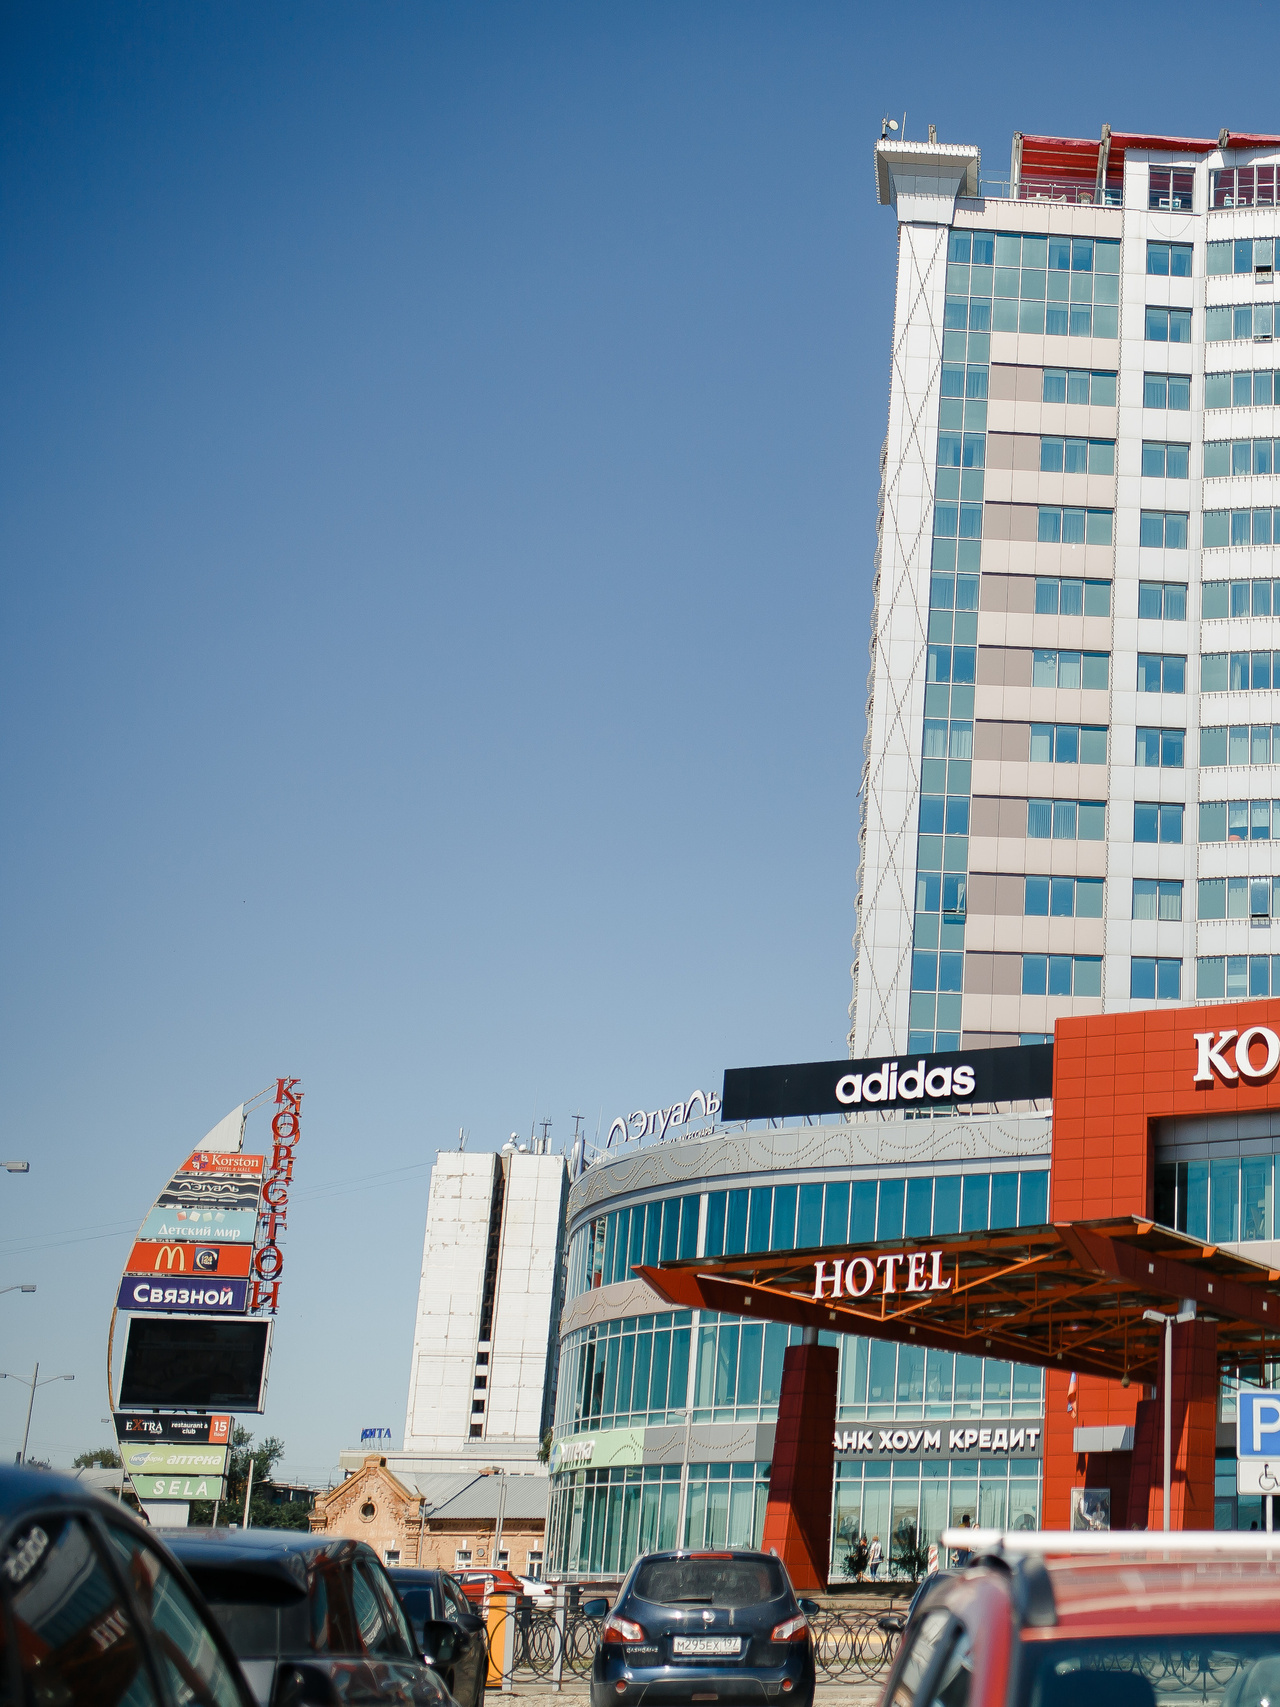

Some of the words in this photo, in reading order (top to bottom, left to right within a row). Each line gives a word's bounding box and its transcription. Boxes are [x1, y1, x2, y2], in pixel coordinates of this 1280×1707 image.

[835, 1060, 976, 1105] adidas
[211, 1154, 259, 1167] Korston
[249, 1078, 302, 1309] КОРСТОН
[158, 1224, 212, 1237] Детский
[214, 1227, 241, 1241] мир
[812, 1251, 952, 1300] HOTEL
[125, 1418, 163, 1431] EXTRA
[171, 1421, 203, 1429] restaurant
[214, 1421, 228, 1432] 15
[878, 1429, 941, 1450] ХОУМ
[949, 1428, 1041, 1451] КРЕДИТ
[166, 1455, 222, 1465] аптека
[152, 1480, 208, 1496] SELA
[722, 1638, 738, 1647] 197
